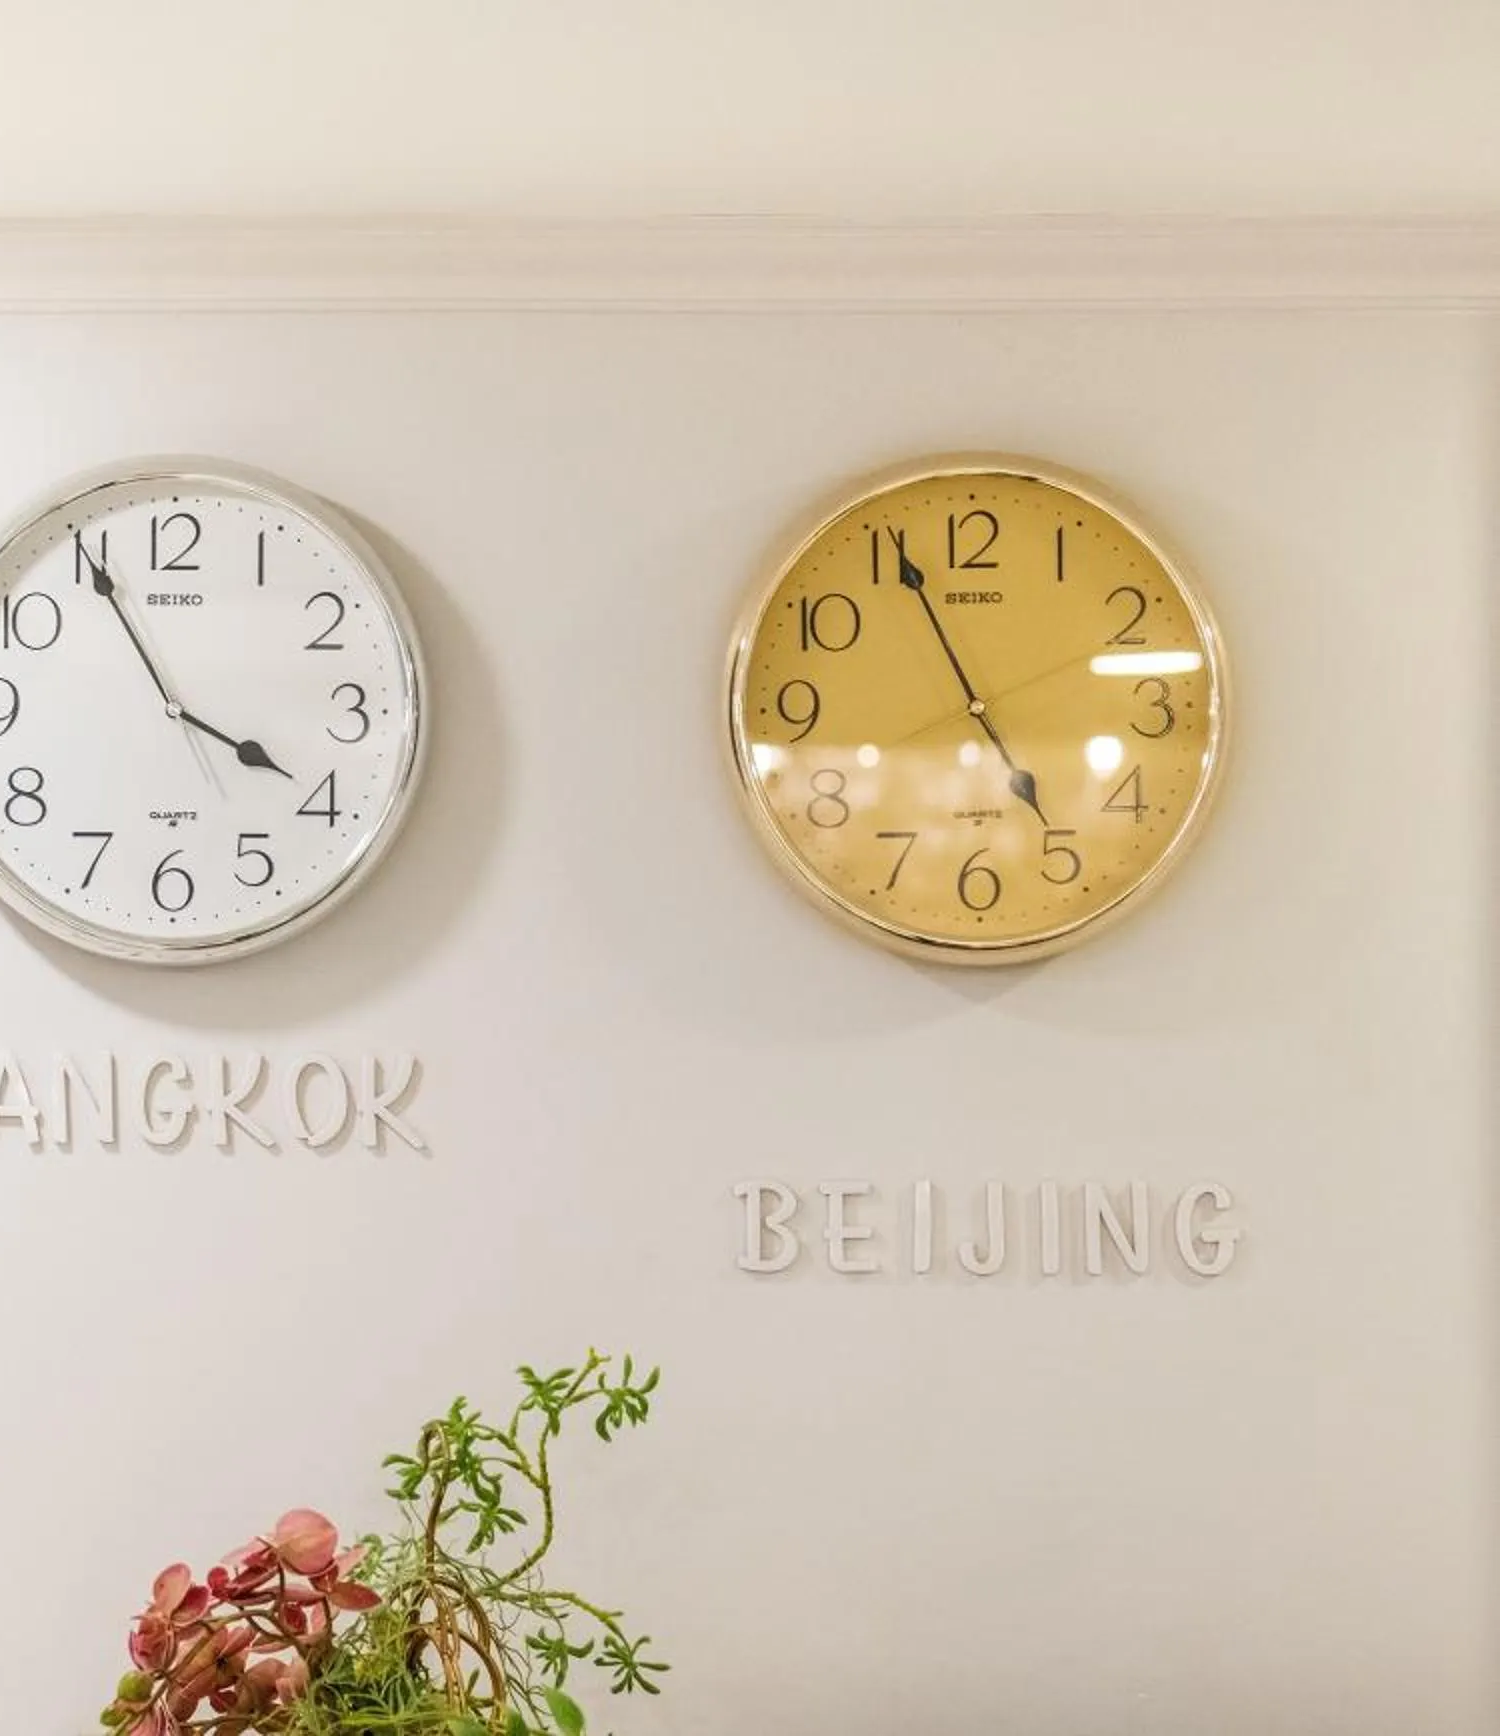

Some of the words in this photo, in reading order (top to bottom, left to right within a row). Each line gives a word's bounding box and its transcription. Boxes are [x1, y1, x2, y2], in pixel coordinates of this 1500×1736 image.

[151, 512, 201, 570] 12
[258, 531, 264, 586] 1
[872, 529, 905, 585] 11
[948, 510, 999, 569] 12
[1057, 526, 1063, 581] 1
[3, 592, 62, 651] 10
[146, 594, 203, 606] SEIKO
[304, 591, 344, 651] 2
[801, 593, 861, 652] 10
[945, 592, 1003, 604] SEIKO
[1104, 586, 1147, 646] 2
[325, 682, 370, 744] 3
[777, 679, 821, 744] 9
[1130, 677, 1176, 739] 3
[4, 767, 48, 826] 8
[149, 812, 197, 821] QUARTZ
[296, 770, 341, 827] 4
[806, 768, 850, 828] 8
[1101, 764, 1149, 823] 4
[72, 831, 113, 889] 7
[151, 849, 195, 912] 6
[233, 833, 275, 887] 5
[877, 832, 917, 891] 7
[957, 848, 1001, 911] 6
[1041, 830, 1081, 884] 5
[731, 1177, 1242, 1278] BEIJING
